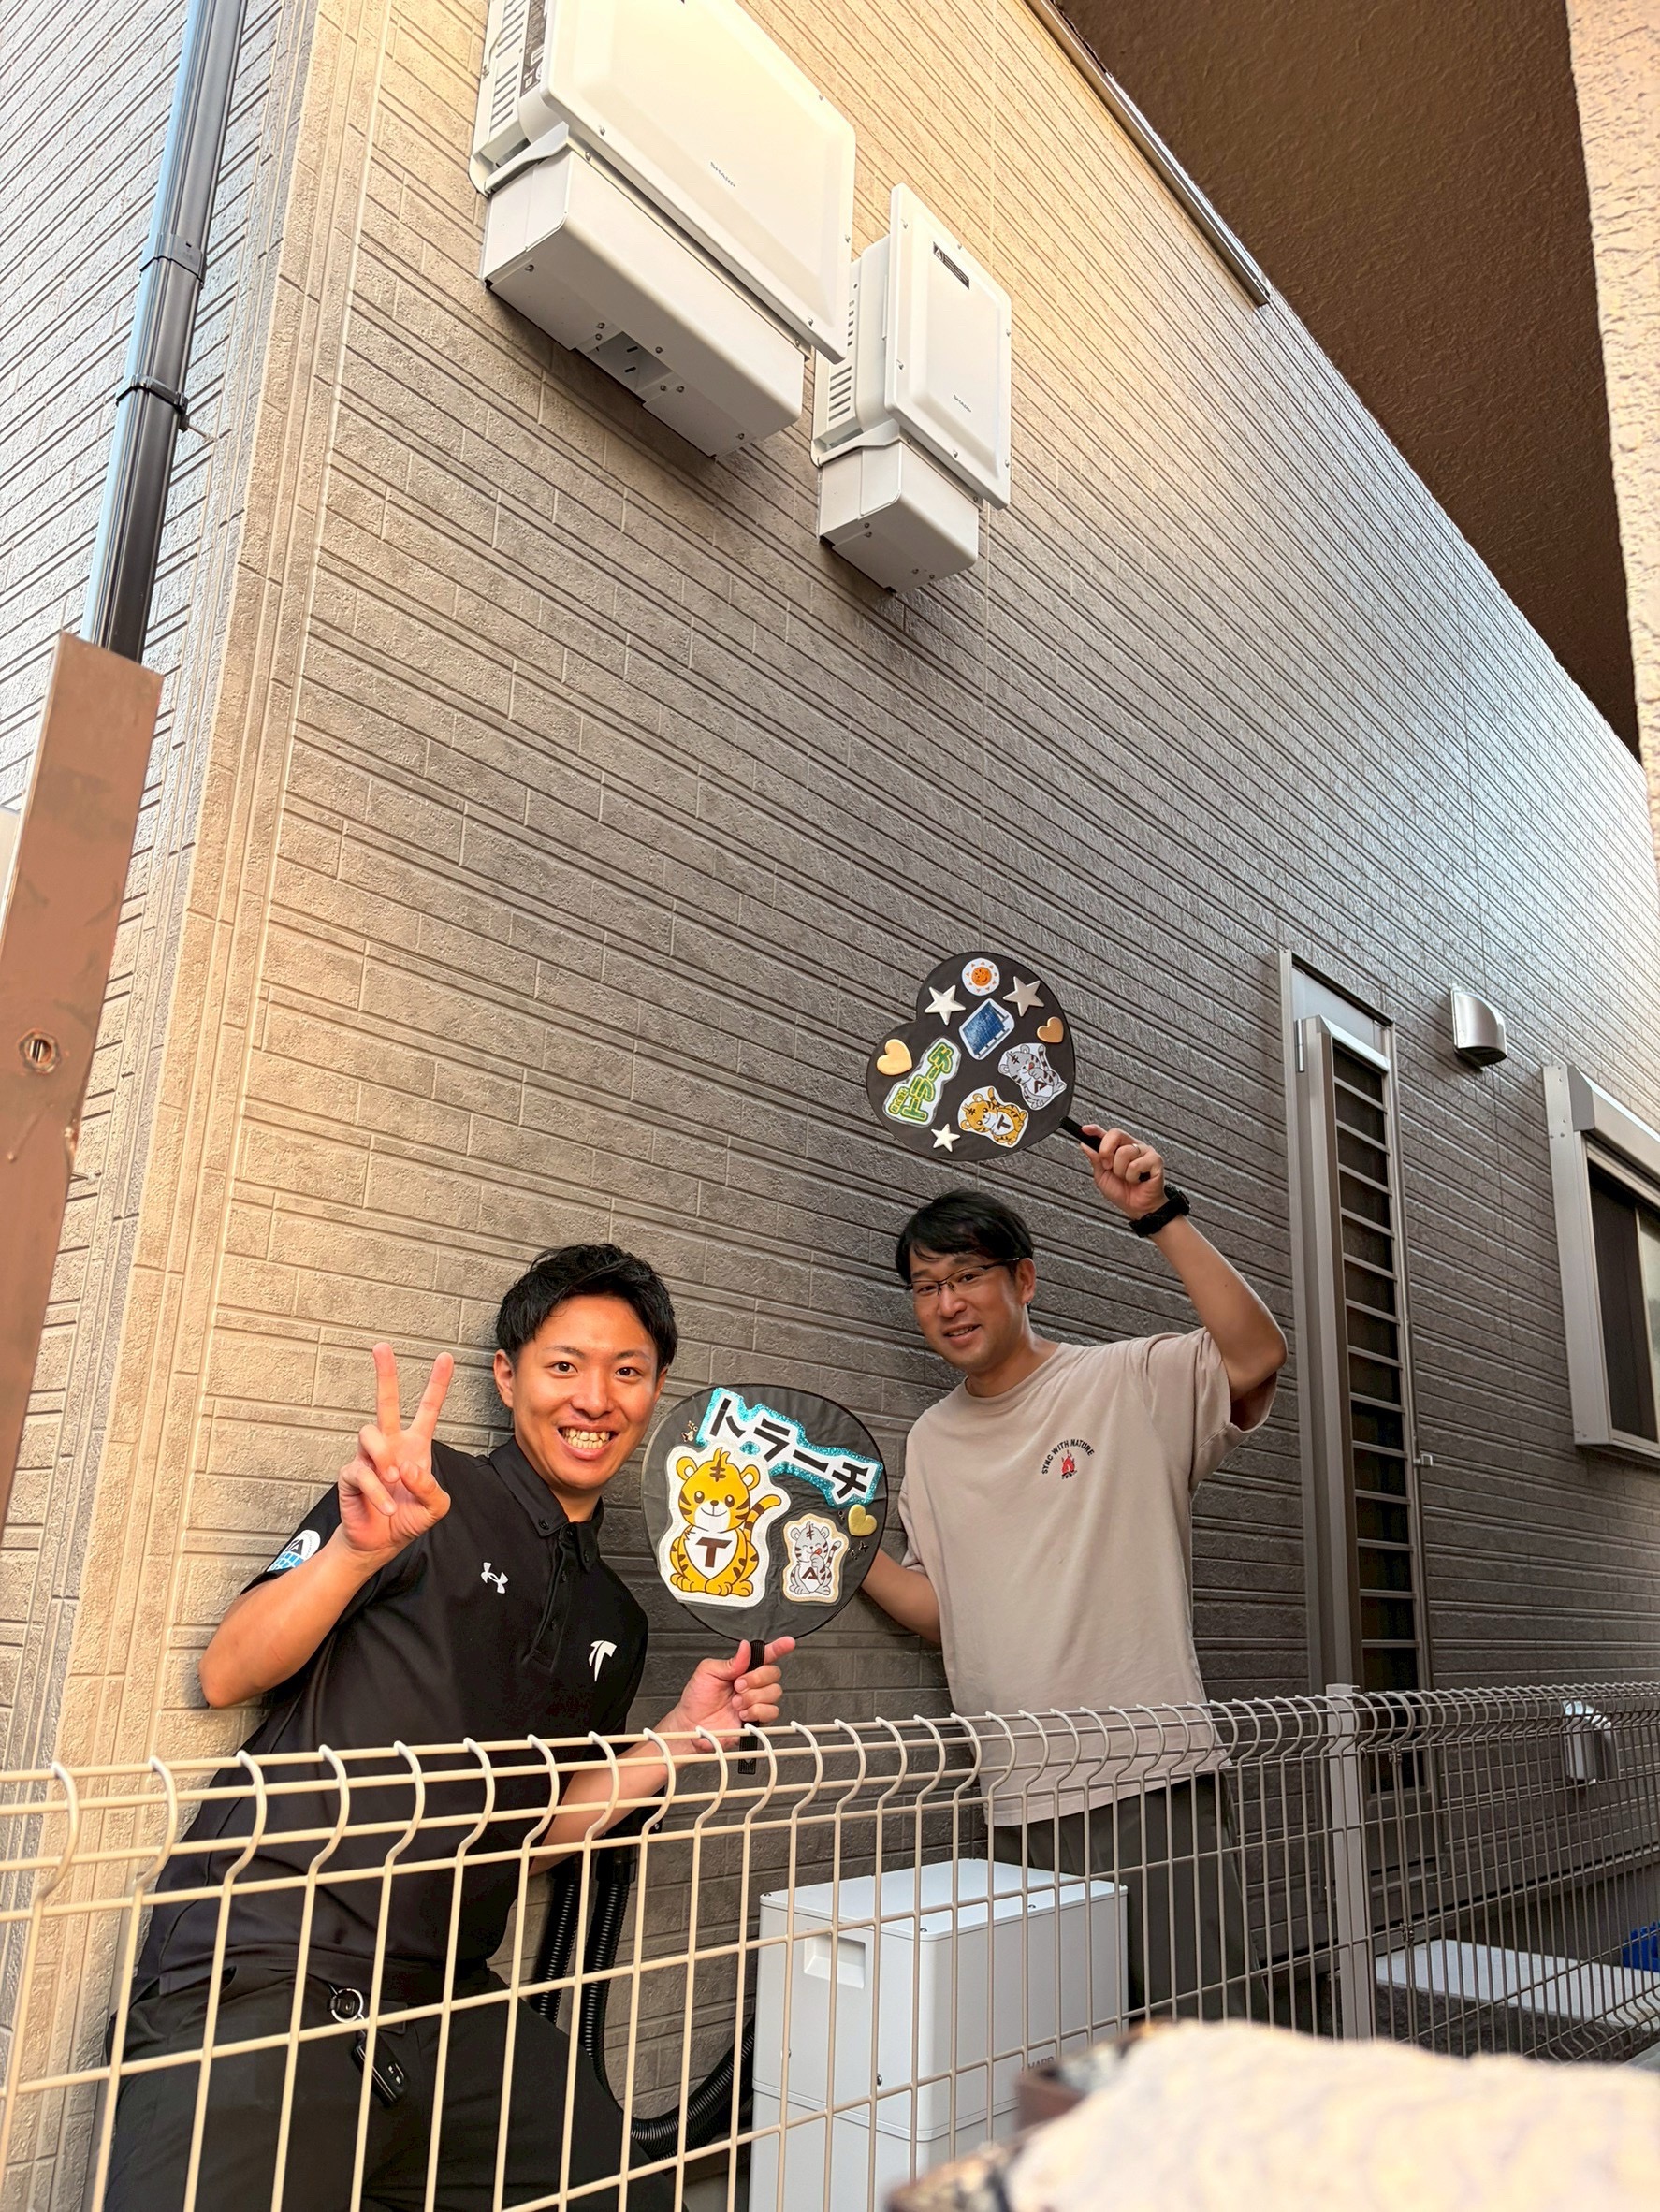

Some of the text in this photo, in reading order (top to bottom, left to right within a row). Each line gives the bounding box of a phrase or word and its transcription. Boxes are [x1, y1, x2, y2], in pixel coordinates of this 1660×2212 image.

[900, 1041, 954, 1122] トラーチ
[709, 1398, 869, 1499] トラーチ
[1041, 1438, 1095, 1475] SYNC WITH NATURE
[695, 1537, 732, 1568] T
